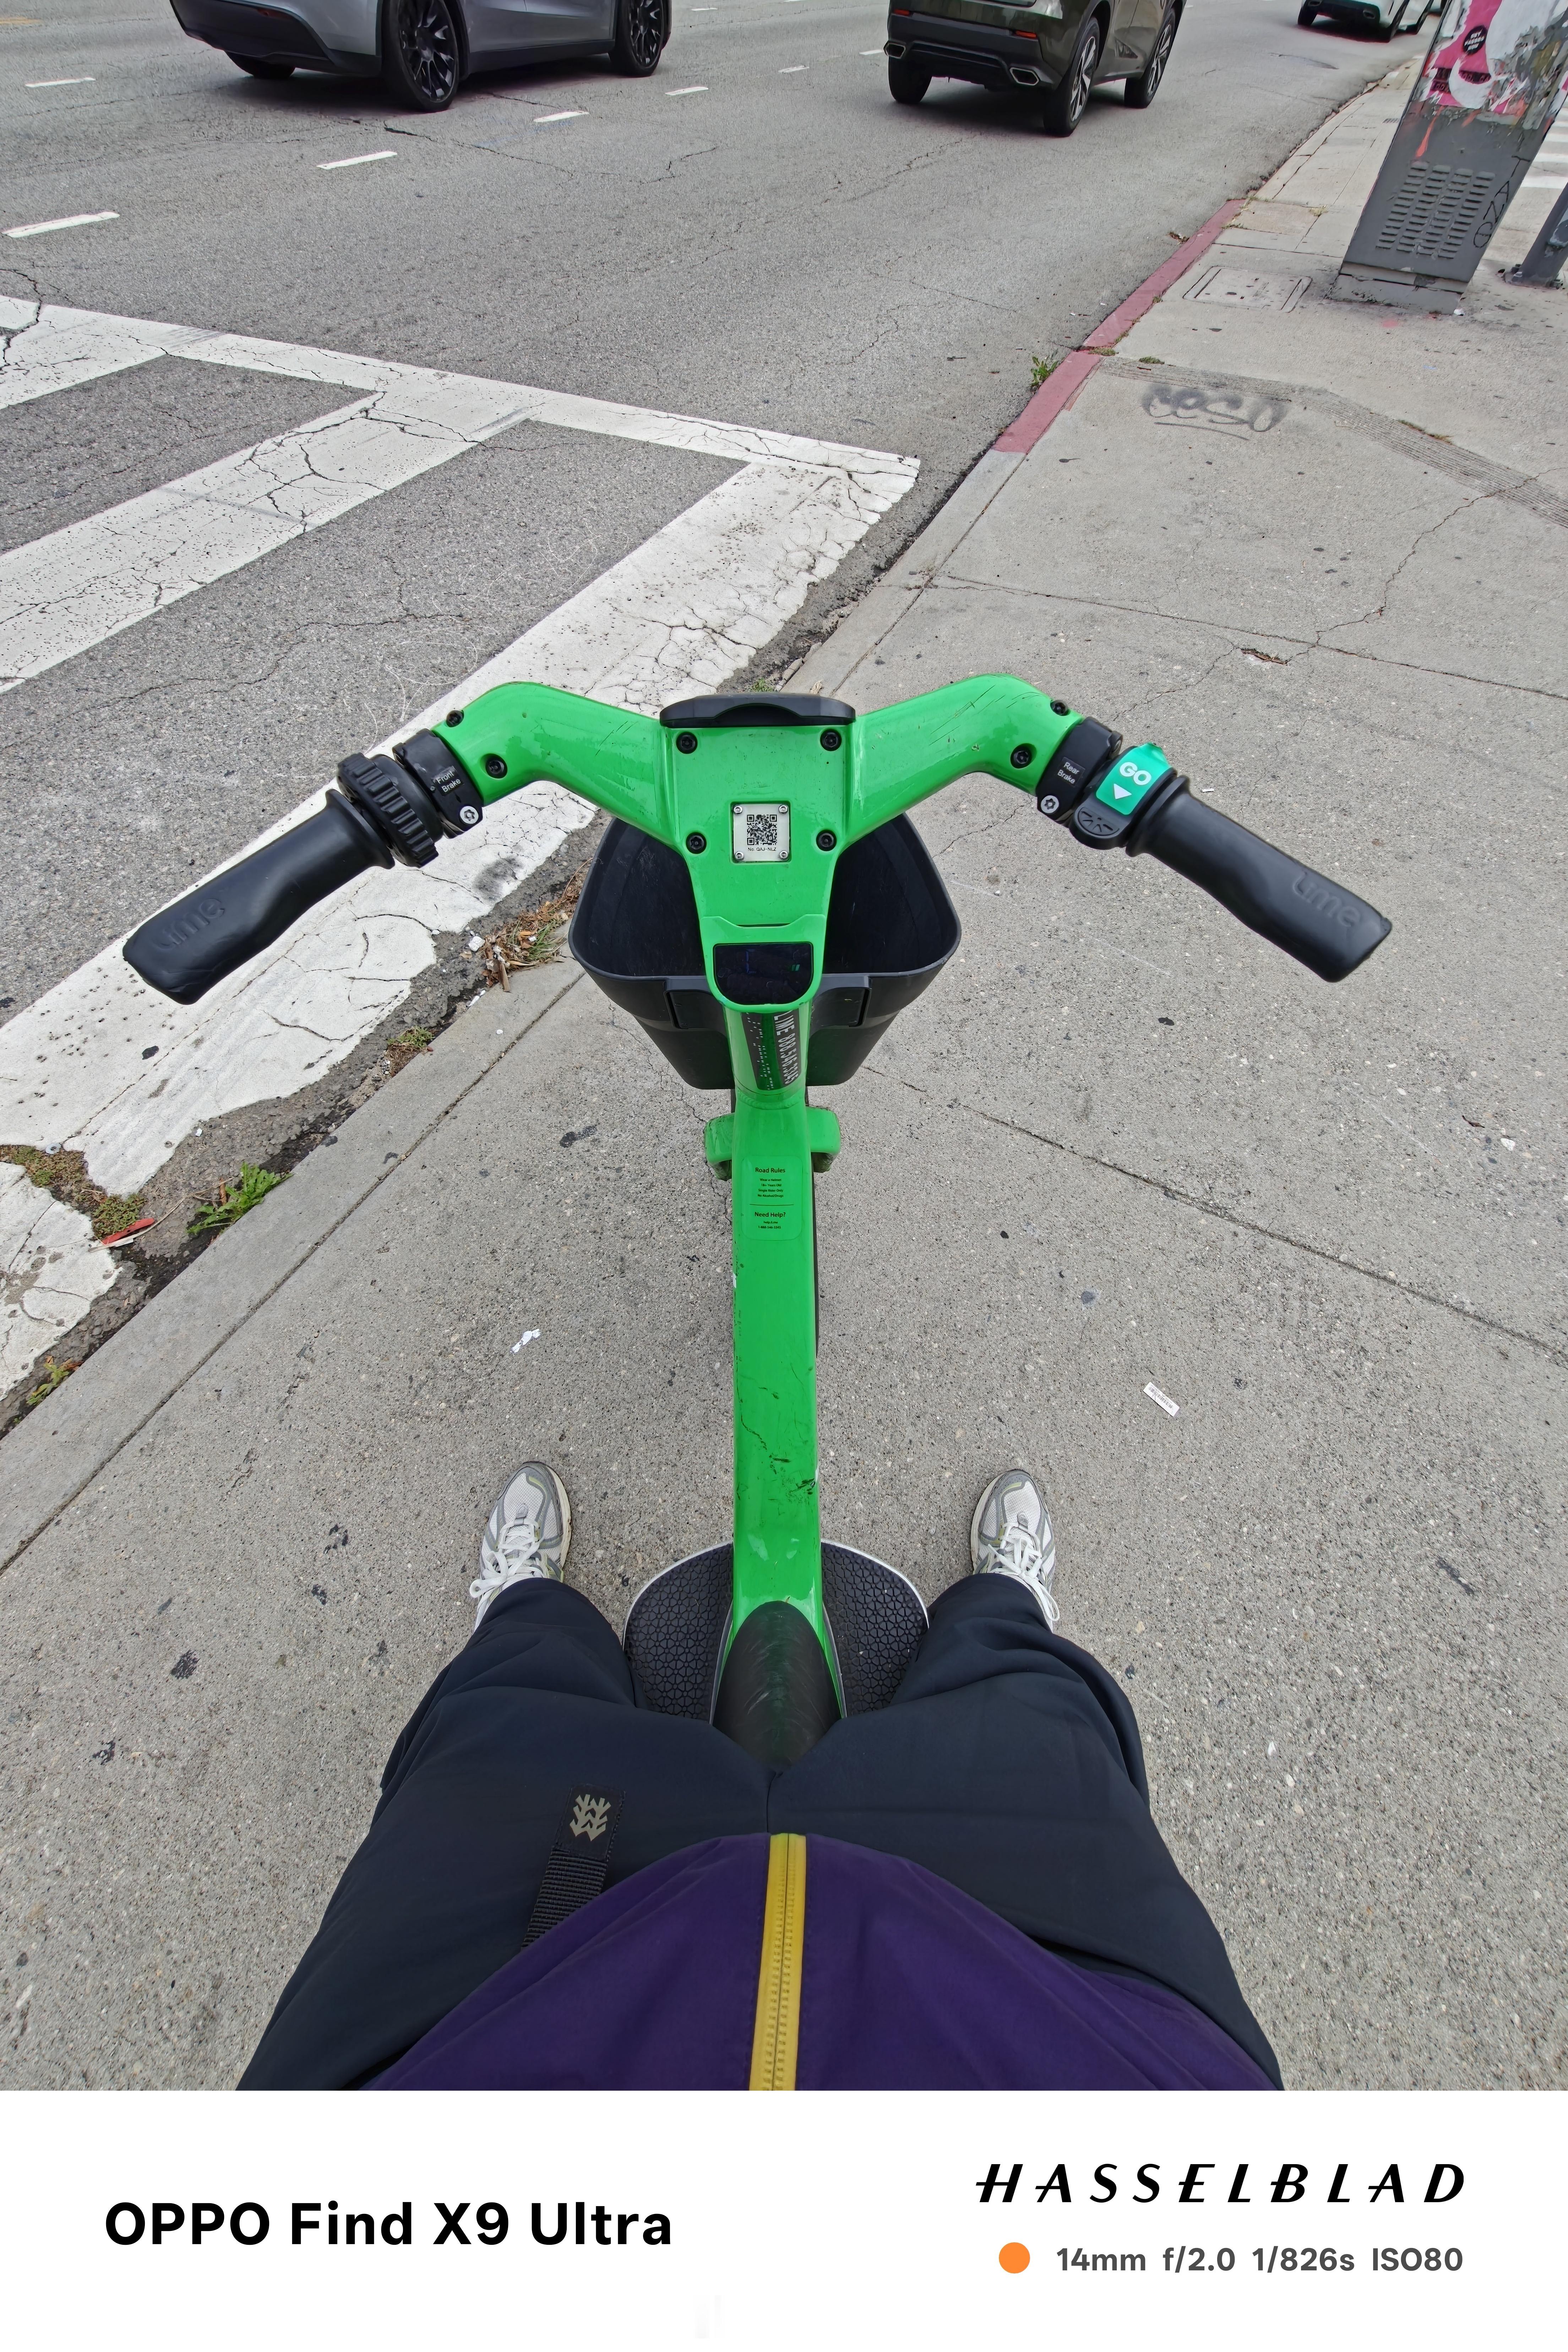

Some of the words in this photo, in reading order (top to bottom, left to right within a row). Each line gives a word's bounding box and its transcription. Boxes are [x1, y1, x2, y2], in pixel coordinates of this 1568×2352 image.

[1063, 762, 1079, 774] Rear
[1120, 762, 1151, 785] GO
[436, 770, 454, 784] Front
[1057, 769, 1075, 784] Brake
[441, 779, 461, 792] Brake
[774, 1010, 795, 1036] LIME
